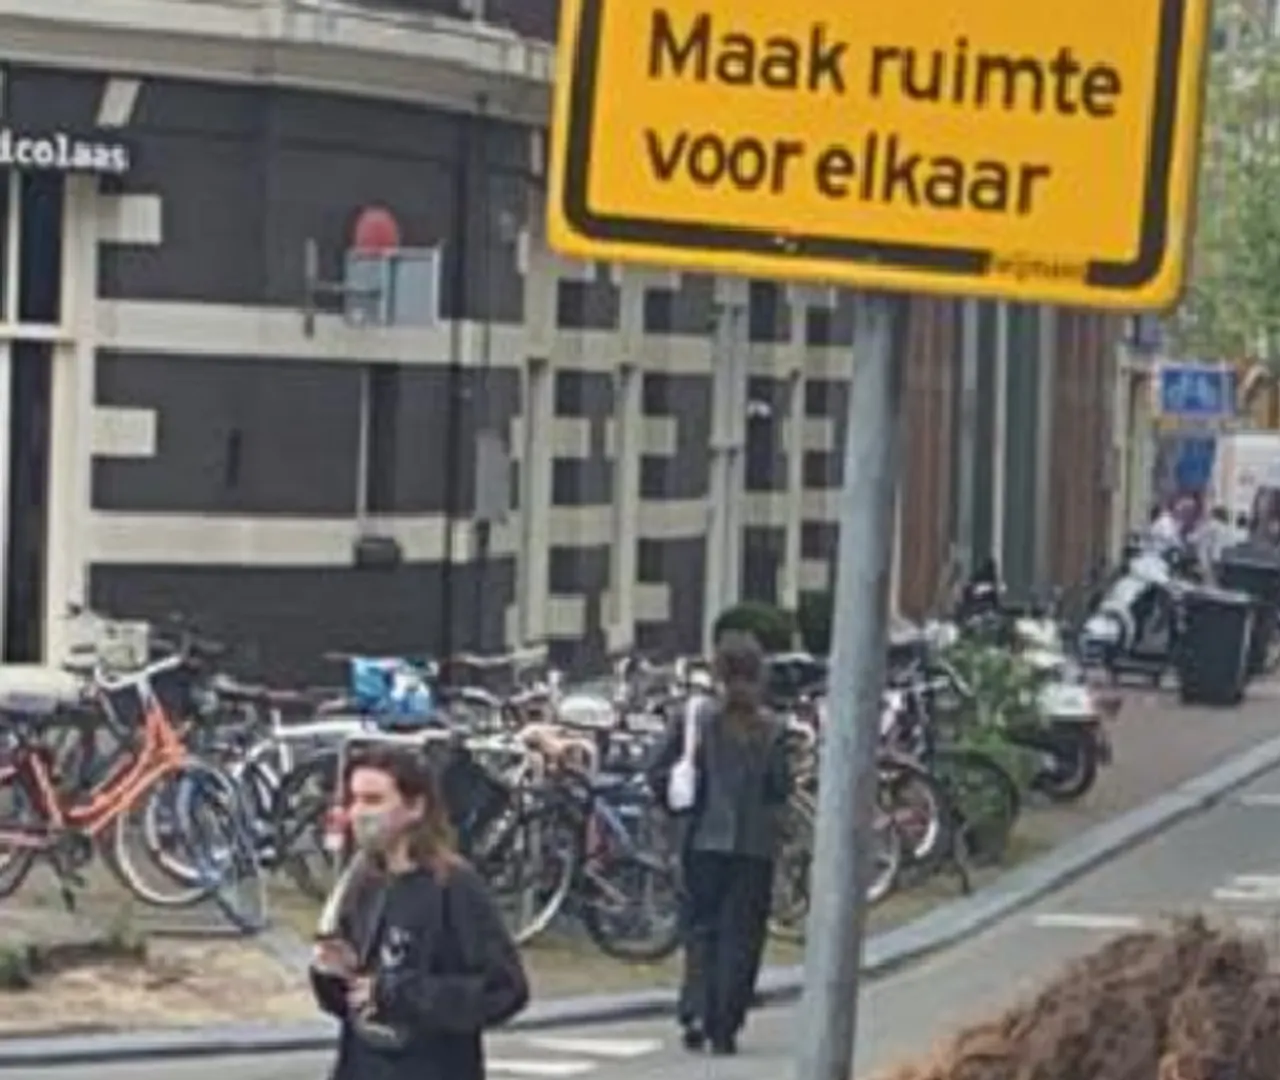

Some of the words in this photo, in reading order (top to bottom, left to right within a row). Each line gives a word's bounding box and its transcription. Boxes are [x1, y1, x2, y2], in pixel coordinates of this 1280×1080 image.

[646, 8, 847, 96] Maak
[868, 36, 1122, 118] ruimte
[643, 127, 804, 195] voor
[814, 131, 1051, 216] elkaar
